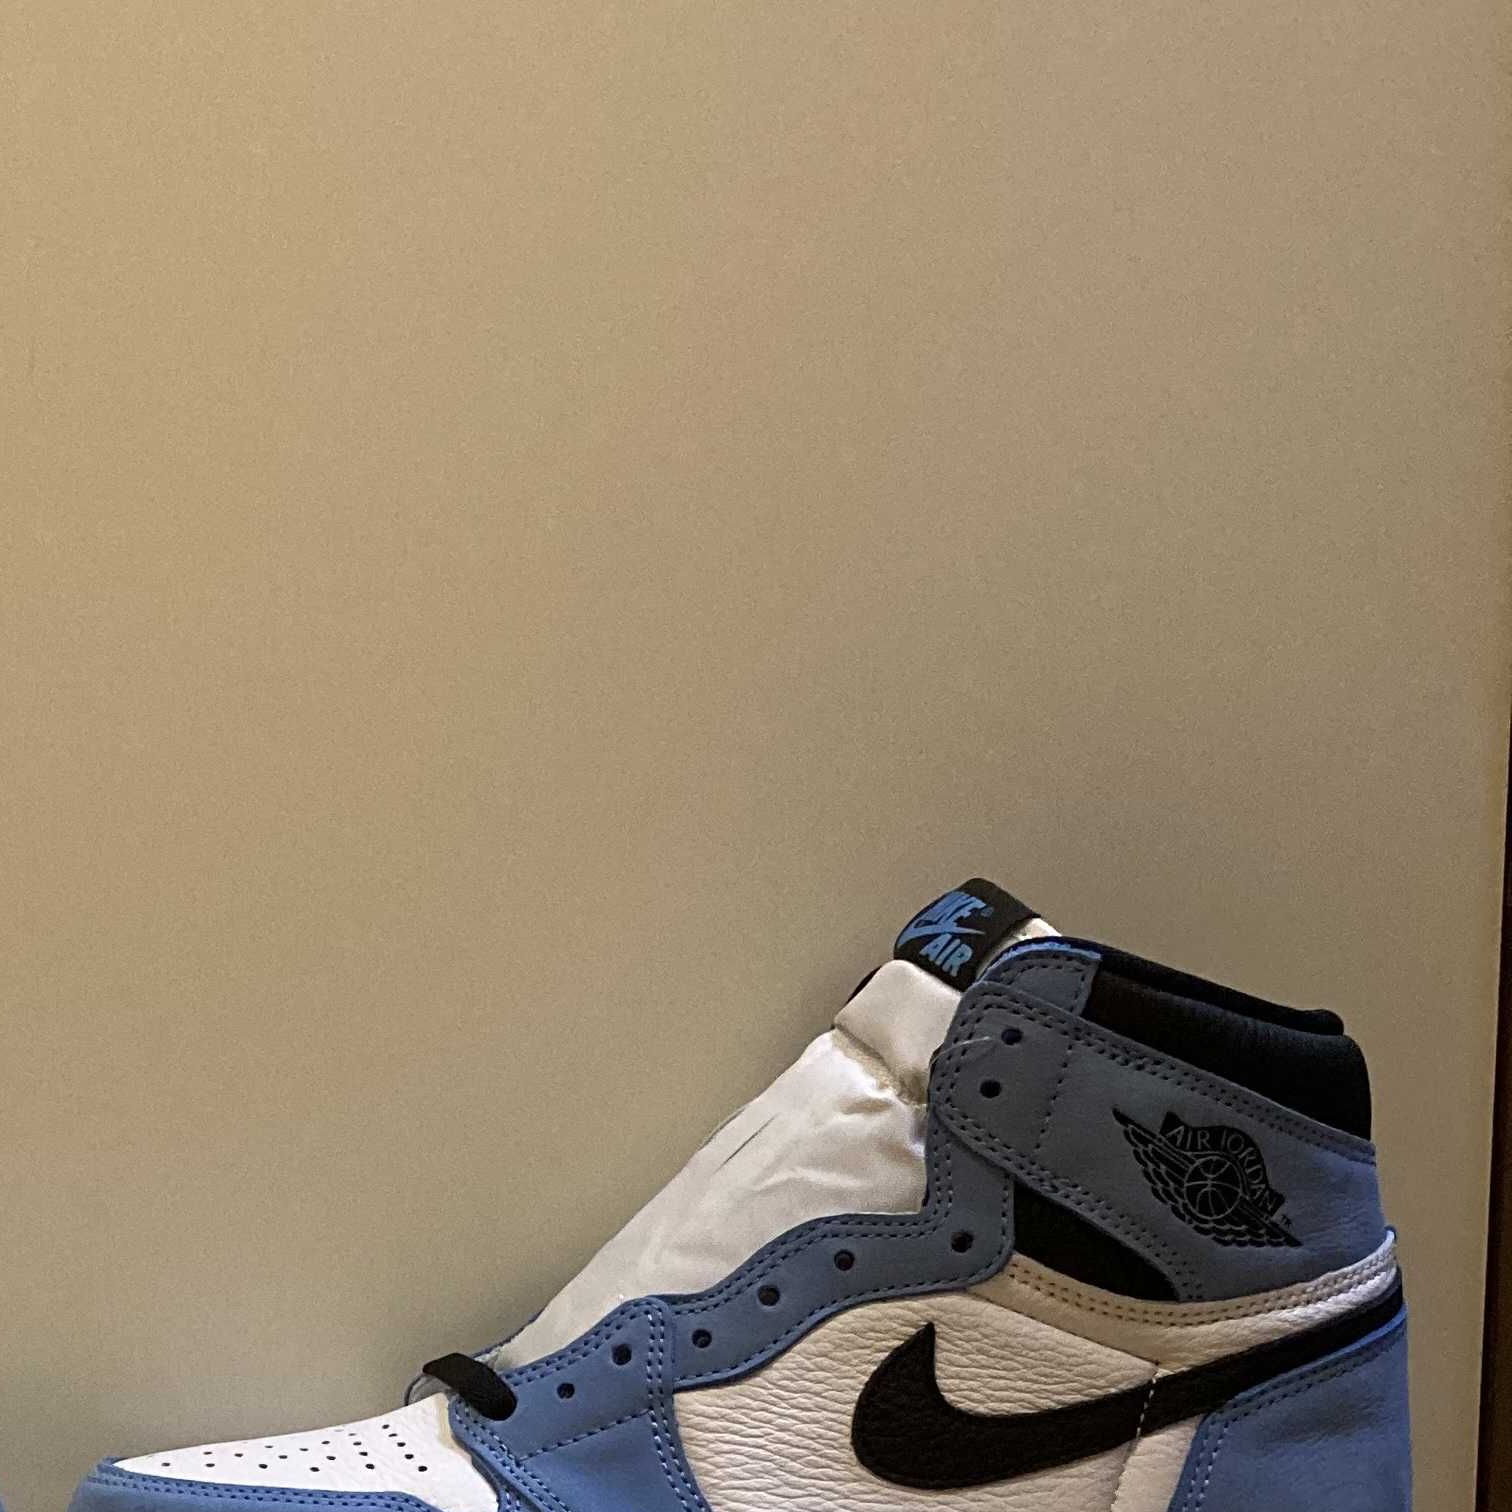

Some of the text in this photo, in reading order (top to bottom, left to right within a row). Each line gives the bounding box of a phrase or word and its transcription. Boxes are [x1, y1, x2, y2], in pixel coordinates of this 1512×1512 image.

[919, 931, 973, 977] AIR
[1165, 1125, 1212, 1151] AIR
[1220, 1130, 1276, 1211] JORDAN
